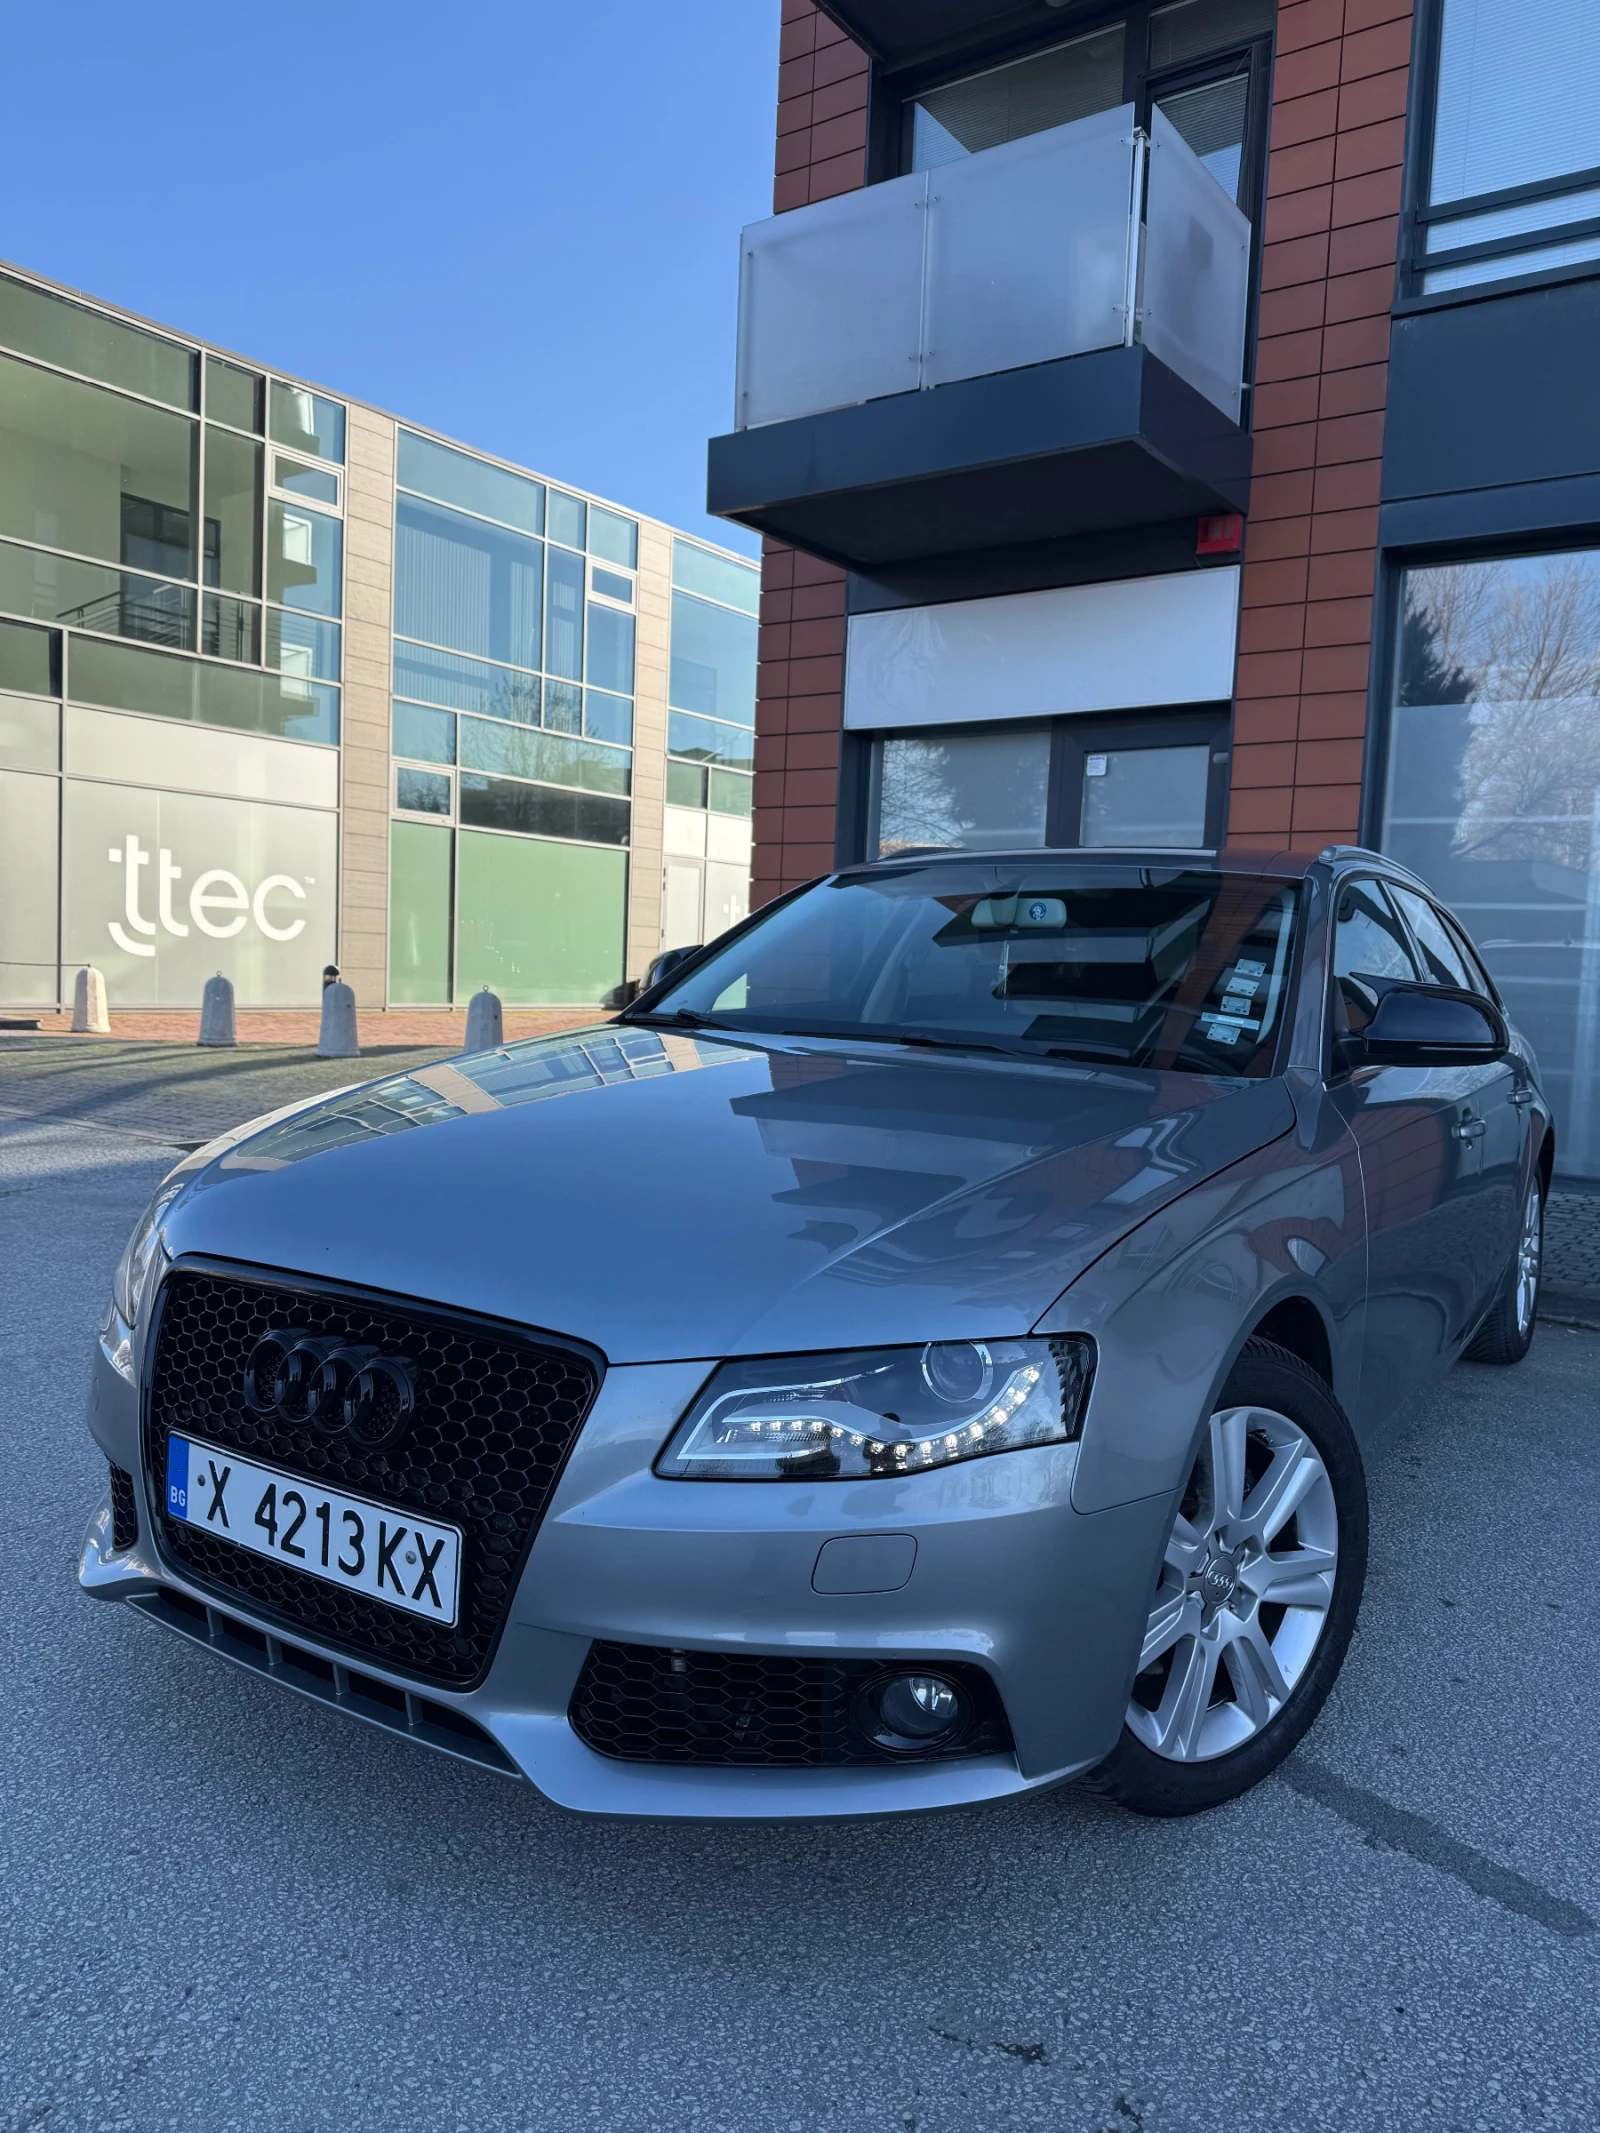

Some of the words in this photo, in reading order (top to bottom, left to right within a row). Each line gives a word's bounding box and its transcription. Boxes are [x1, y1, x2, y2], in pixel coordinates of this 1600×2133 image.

[107, 834, 306, 957] ttec
[170, 1485, 187, 1507] BG
[207, 1459, 231, 1528] X
